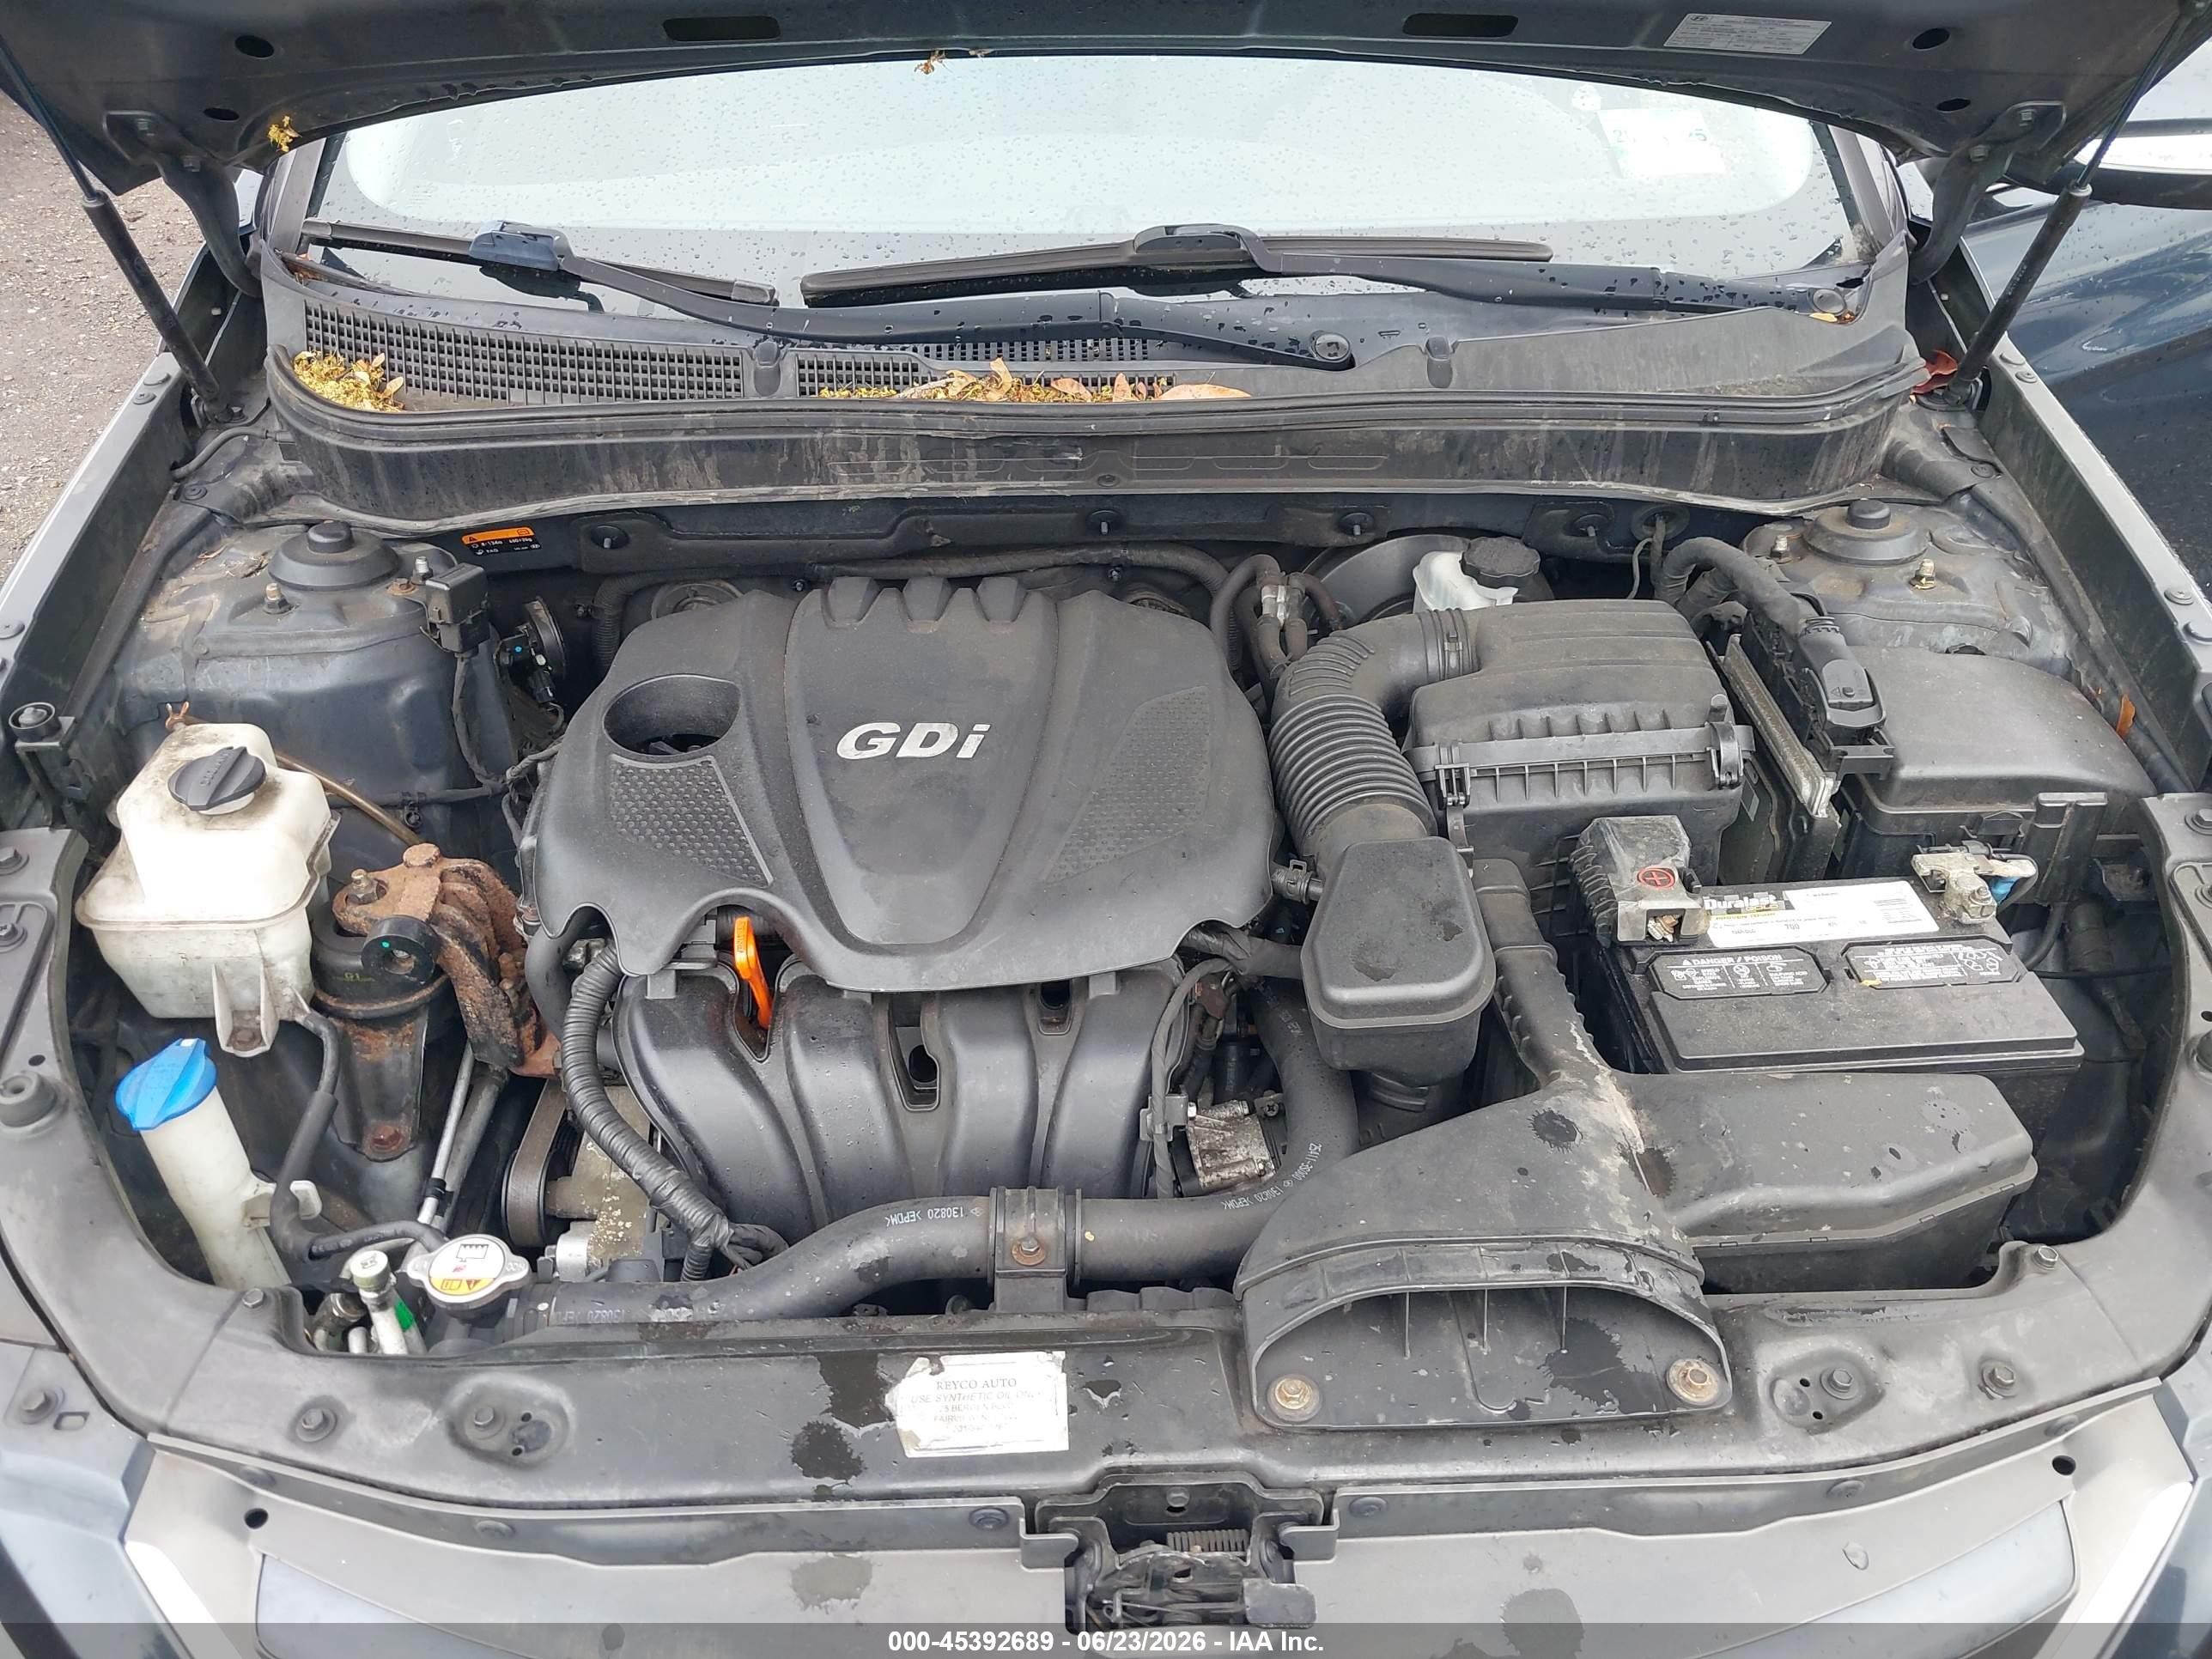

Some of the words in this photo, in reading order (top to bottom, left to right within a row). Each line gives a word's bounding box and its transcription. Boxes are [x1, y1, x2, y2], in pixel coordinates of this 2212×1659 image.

[836, 722, 991, 760] GDi
[1703, 894, 1778, 910] Duralast
[1692, 957, 1735, 966] DANGER
[1744, 954, 1783, 963] POISON
[927, 1206, 964, 1220] 130820
[936, 1379, 978, 1390] REYCO
[981, 1377, 1018, 1389] AUTO
[910, 1395, 931, 1404] USE
[935, 1392, 994, 1403] SYNTHETIC
